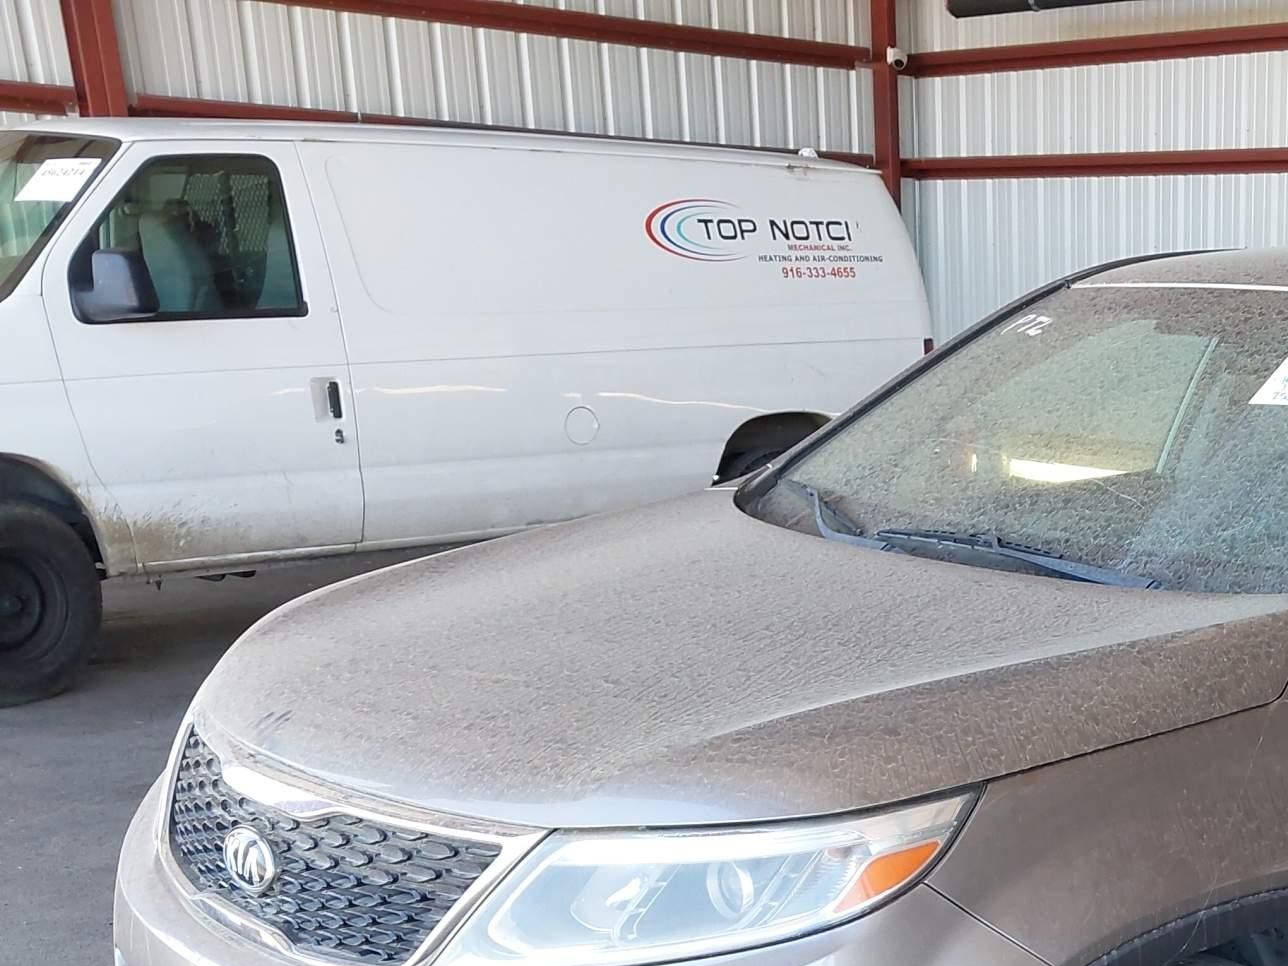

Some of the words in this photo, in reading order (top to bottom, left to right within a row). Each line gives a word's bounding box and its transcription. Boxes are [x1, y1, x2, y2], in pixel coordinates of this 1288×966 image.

[697, 218, 757, 241] TOP
[758, 254, 792, 262] HEATING
[813, 255, 883, 263] AIR-CONDITIONING
[781, 266, 856, 278] 916-333-4655
